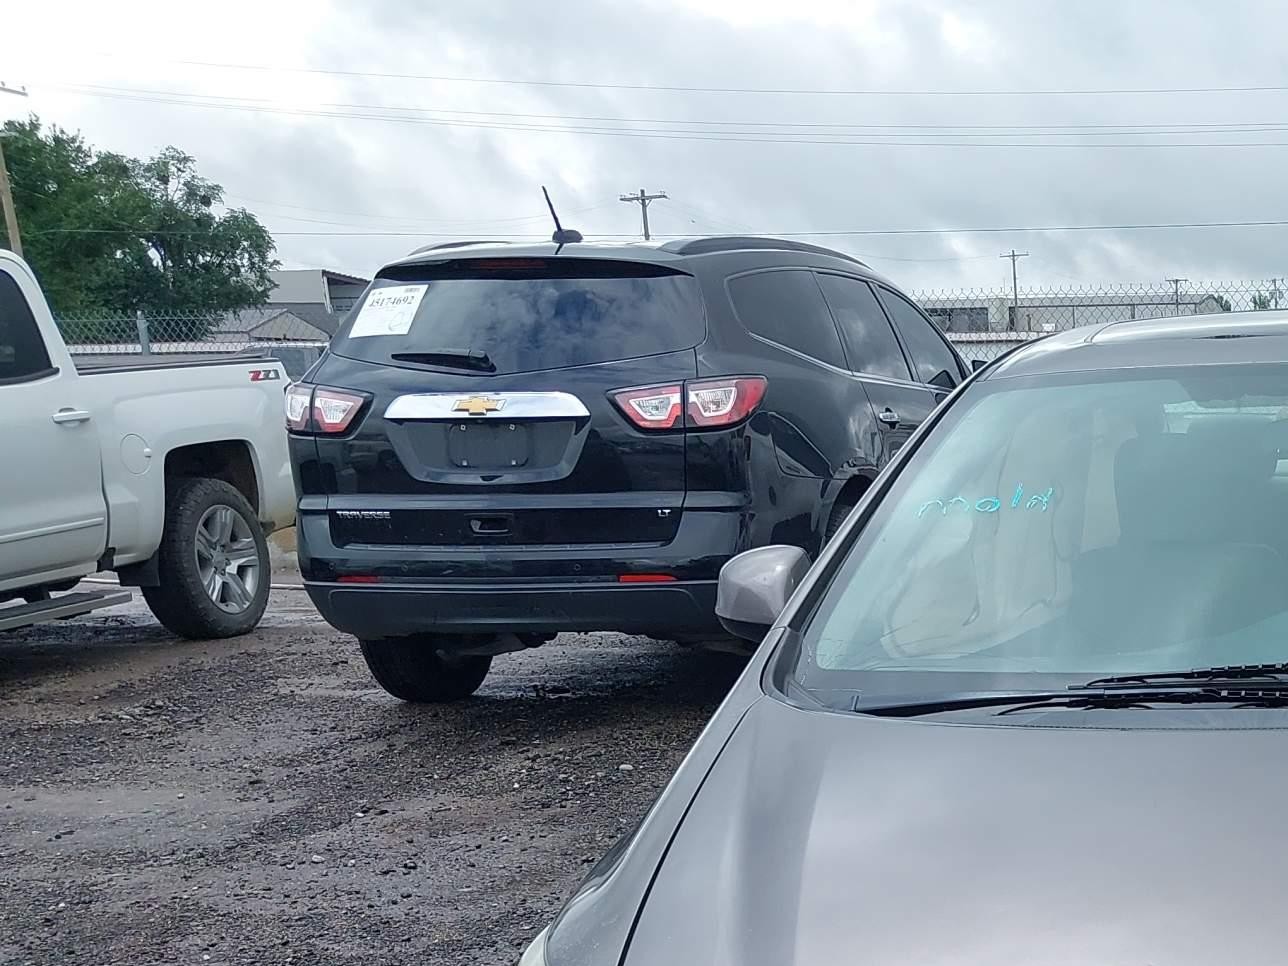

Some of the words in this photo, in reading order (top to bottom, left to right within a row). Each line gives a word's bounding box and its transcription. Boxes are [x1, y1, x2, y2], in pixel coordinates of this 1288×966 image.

[248, 369, 281, 381] Z71
[336, 511, 391, 519] TRAVERSE
[657, 509, 671, 517] LT
